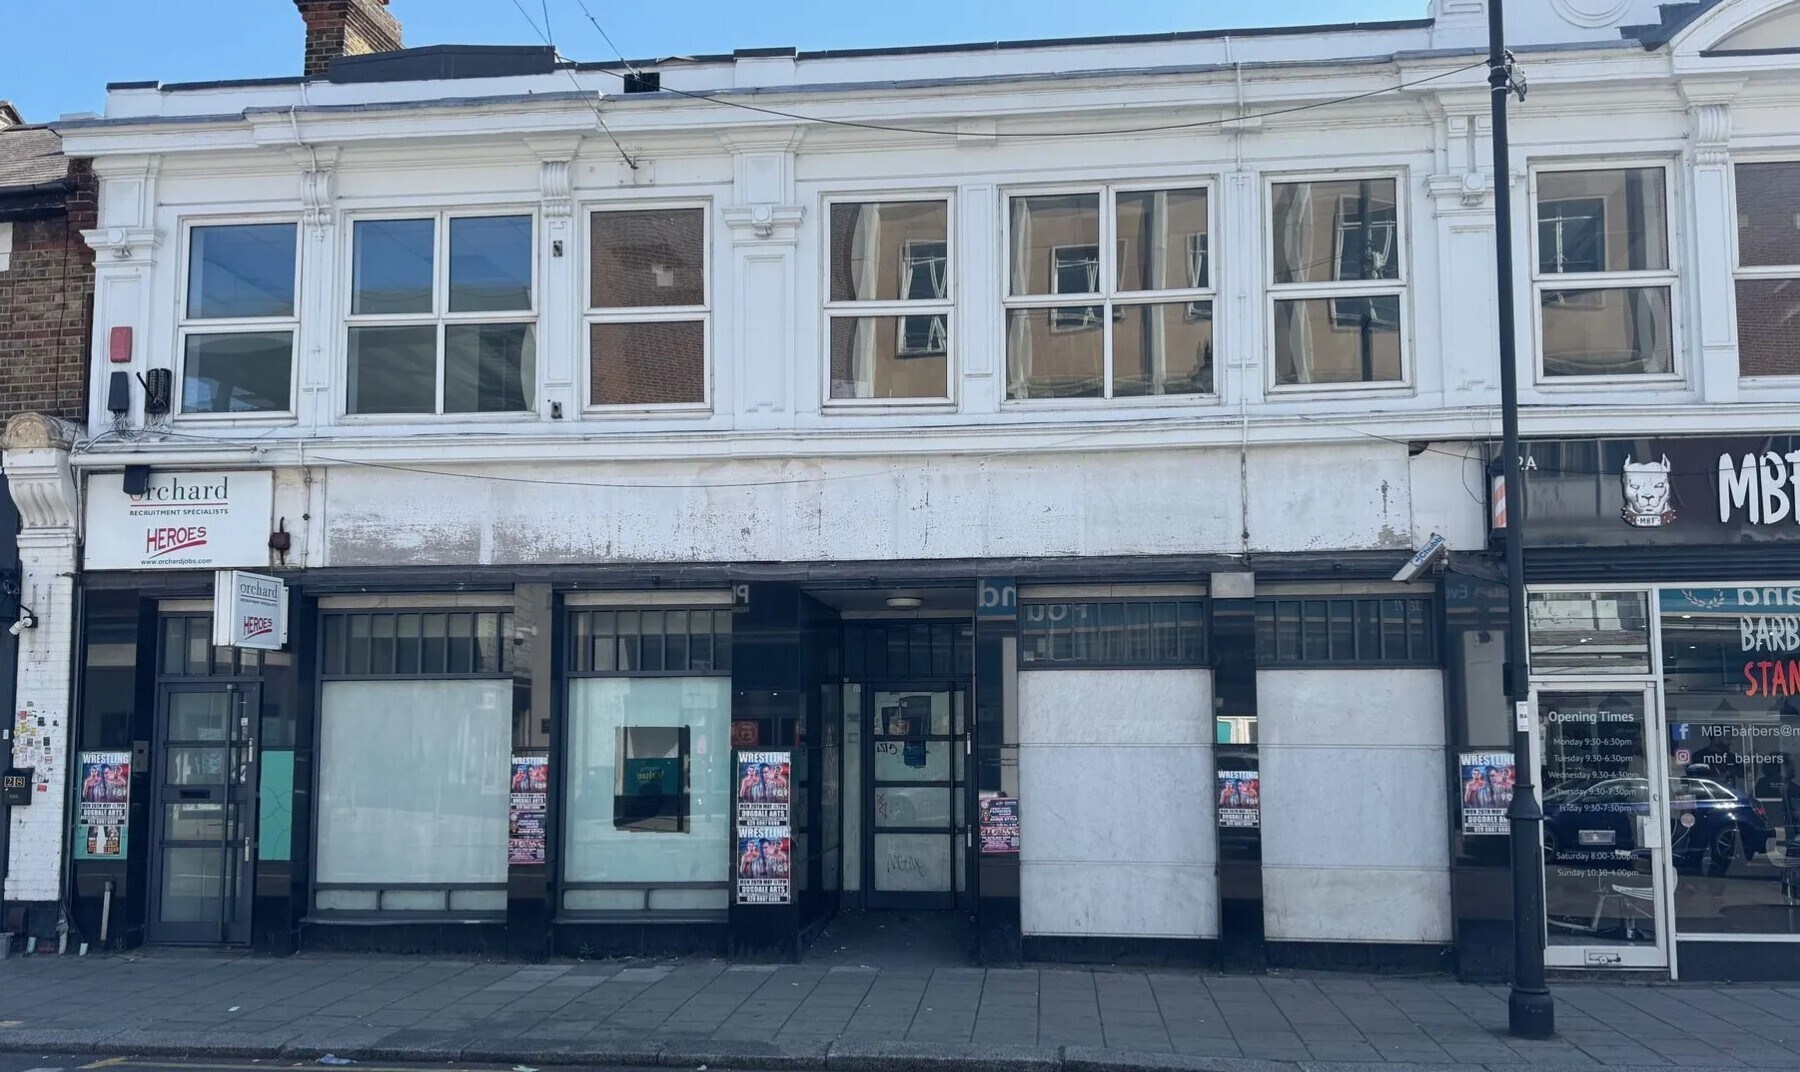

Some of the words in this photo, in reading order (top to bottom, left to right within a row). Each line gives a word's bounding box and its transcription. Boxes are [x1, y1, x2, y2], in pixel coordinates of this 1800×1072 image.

[130, 476, 228, 501] rchard
[146, 526, 207, 553] HEROES
[1419, 537, 1442, 559] Chubb
[240, 580, 278, 598] orchard
[244, 616, 273, 636] HEROES
[1740, 614, 1800, 652] BARB
[1548, 711, 1597, 725] Opening
[1599, 711, 1635, 722] Times
[1553, 738, 1583, 747] Monday
[83, 754, 129, 764] WRESTLING
[511, 757, 548, 765] WRESTLING
[738, 752, 790, 763] WRESTLING
[1554, 755, 1584, 763] Tuesday
[1703, 752, 1784, 766] mbf_barbers
[1218, 771, 1259, 779] WRESTLING
[1548, 771, 1590, 780] Wednesday
[1554, 788, 1586, 796] Thursday
[1559, 804, 1582, 813] Friday
[739, 827, 789, 838] WRESTLING
[1556, 852, 1589, 861] Saturday
[1557, 869, 1585, 877] Sunday
